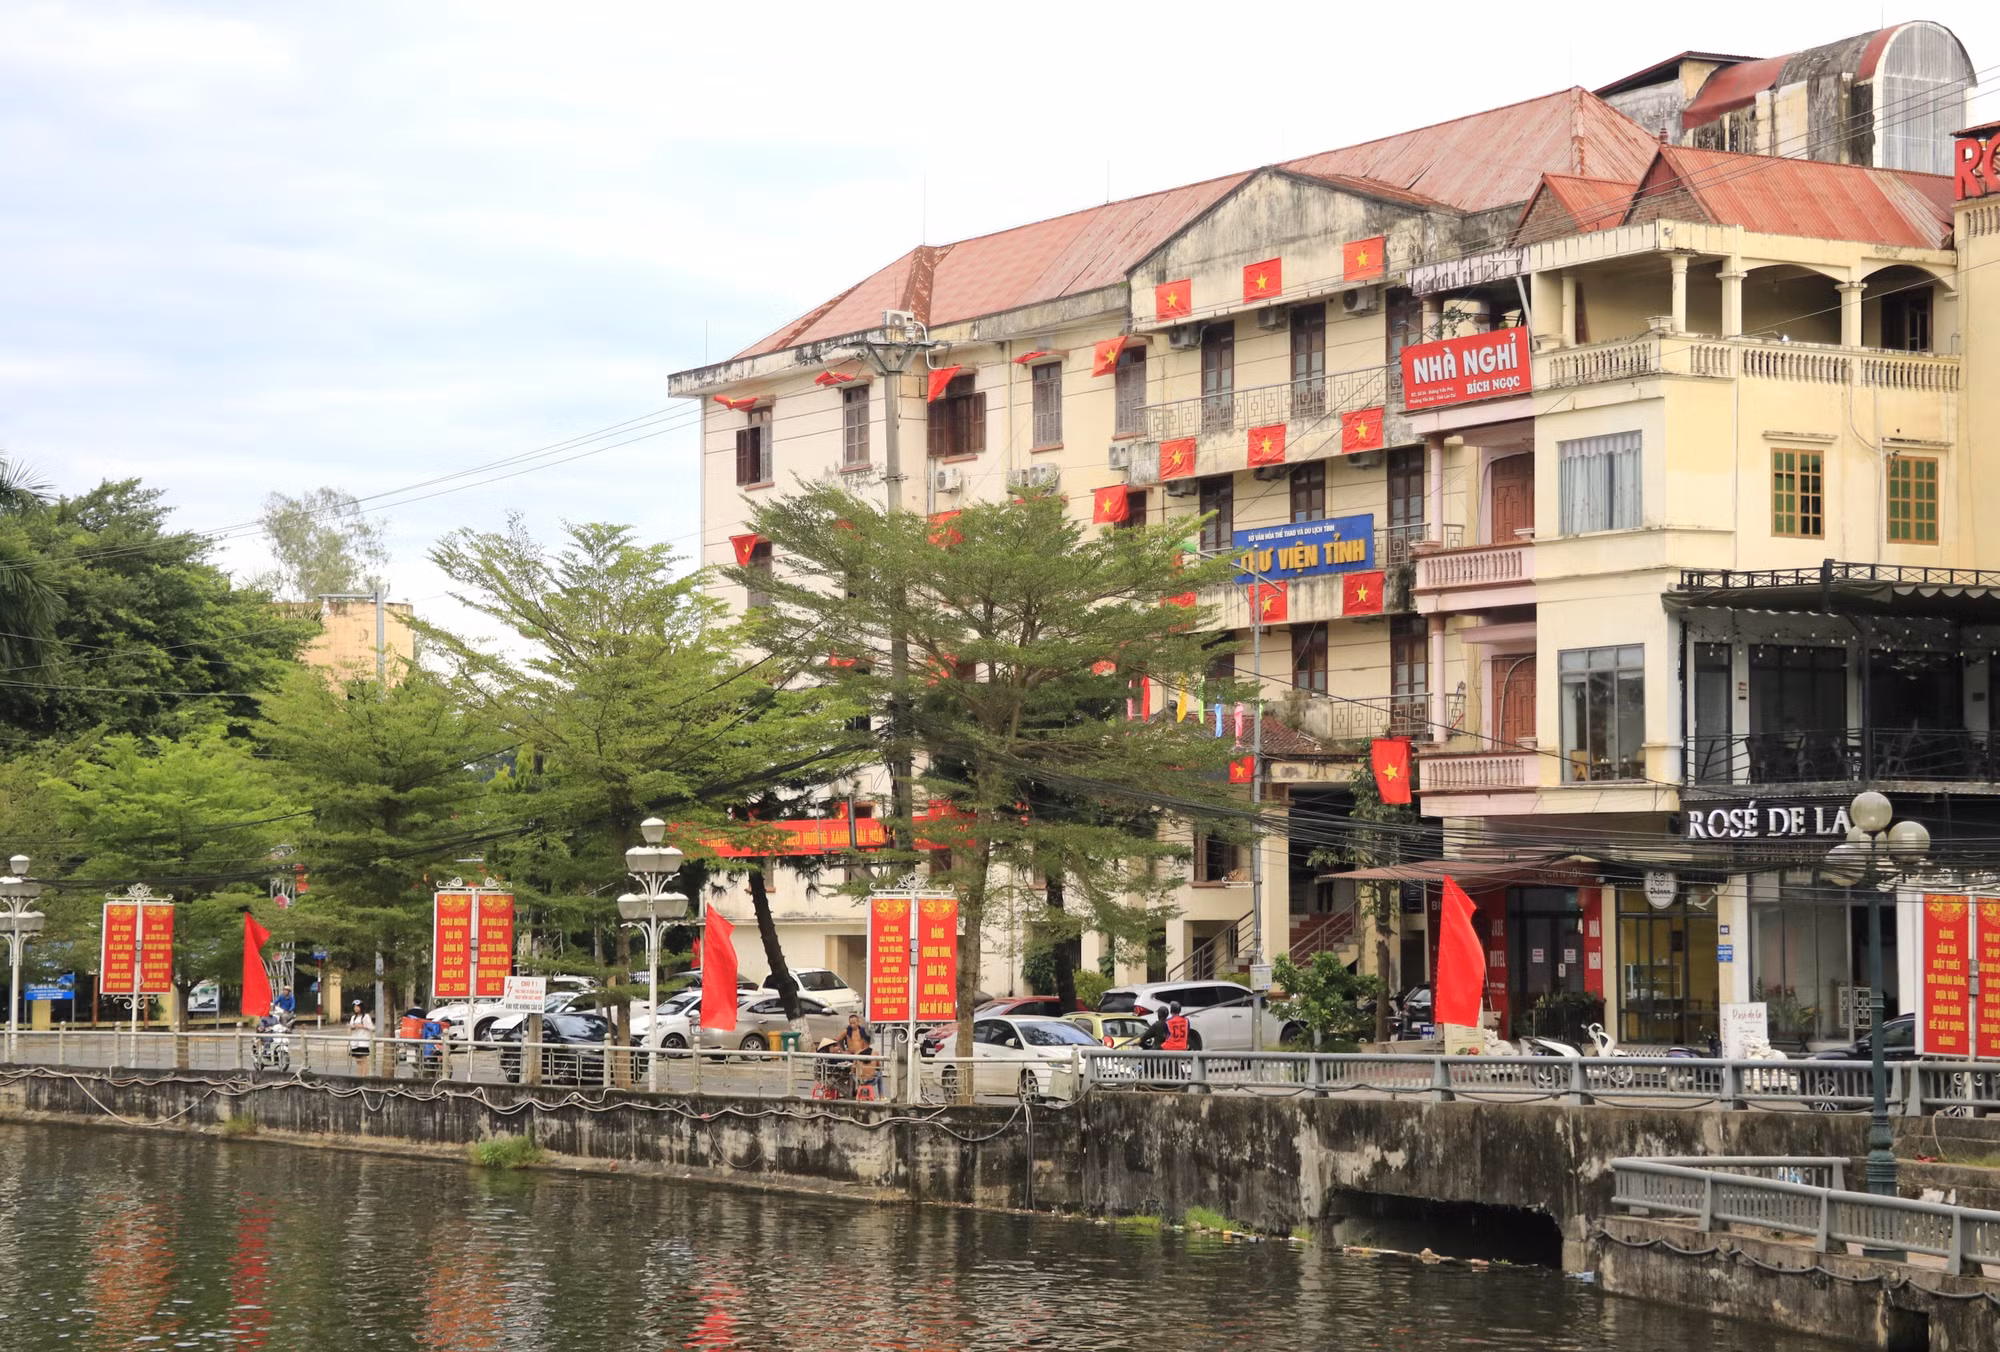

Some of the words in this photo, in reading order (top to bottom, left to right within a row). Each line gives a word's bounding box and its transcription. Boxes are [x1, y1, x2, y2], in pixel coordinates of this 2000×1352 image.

[1414, 348, 1456, 384] NHÀ
[1462, 332, 1518, 376] NGHỈ
[1466, 379, 1490, 394] BÍCH
[1492, 376, 1520, 391] NGỌC
[1248, 532, 1254, 542] SỞ
[1255, 532, 1264, 541] VĂN
[1265, 530, 1274, 540] HÓA
[1275, 528, 1283, 538] THỂ
[1297, 526, 1304, 536] VÀ
[1313, 526, 1322, 535] LỊCH
[1323, 523, 1335, 532] TỈNH
[1278, 540, 1318, 573] VIỆN
[1322, 532, 1366, 565] TỈNH
[1688, 801, 1758, 839] ROSÉ
[1768, 806, 1806, 836] DE
[1814, 805, 1852, 834] LA
[803, 827, 827, 845] HƯỚNG
[931, 924, 944, 939] ĐẢNG
[1589, 916, 1600, 938] NHÀ
[1939, 927, 1954, 939] ĐẢNG
[443, 942, 456, 952] ĐẢNG
[923, 946, 938, 958] QUANG
[1936, 942, 1948, 954] GẮN
[1949, 944, 1957, 954] BÓ
[443, 956, 453, 965] CÁC
[454, 956, 463, 965] CẤP
[1489, 950, 1505, 967] MOTEL
[1933, 958, 1945, 971] MẬT
[1946, 958, 1960, 970] THIẾT
[927, 963, 937, 976] DÂN
[938, 963, 947, 978] TỘC
[1927, 972, 1936, 984] VỚI
[1937, 973, 1952, 985] NHÂN
[1953, 974, 1966, 986] DÂN,
[439, 983, 450, 992] 2025
[924, 984, 934, 995] ANH
[1936, 990, 1946, 1001] DỰA
[1947, 989, 1958, 1000] VÀO
[920, 1000, 929, 1014] BÁC
[930, 999, 937, 1014] HỒ
[937, 1000, 942, 1014] VĨ
[1933, 1004, 1948, 1015] NHÂN
[1950, 1004, 1961, 1016] DÂN
[1929, 1016, 1937, 1030] ĐỂ
[1938, 1019, 1948, 1030] XÂY
[1950, 1021, 1964, 1032] DỰNG
